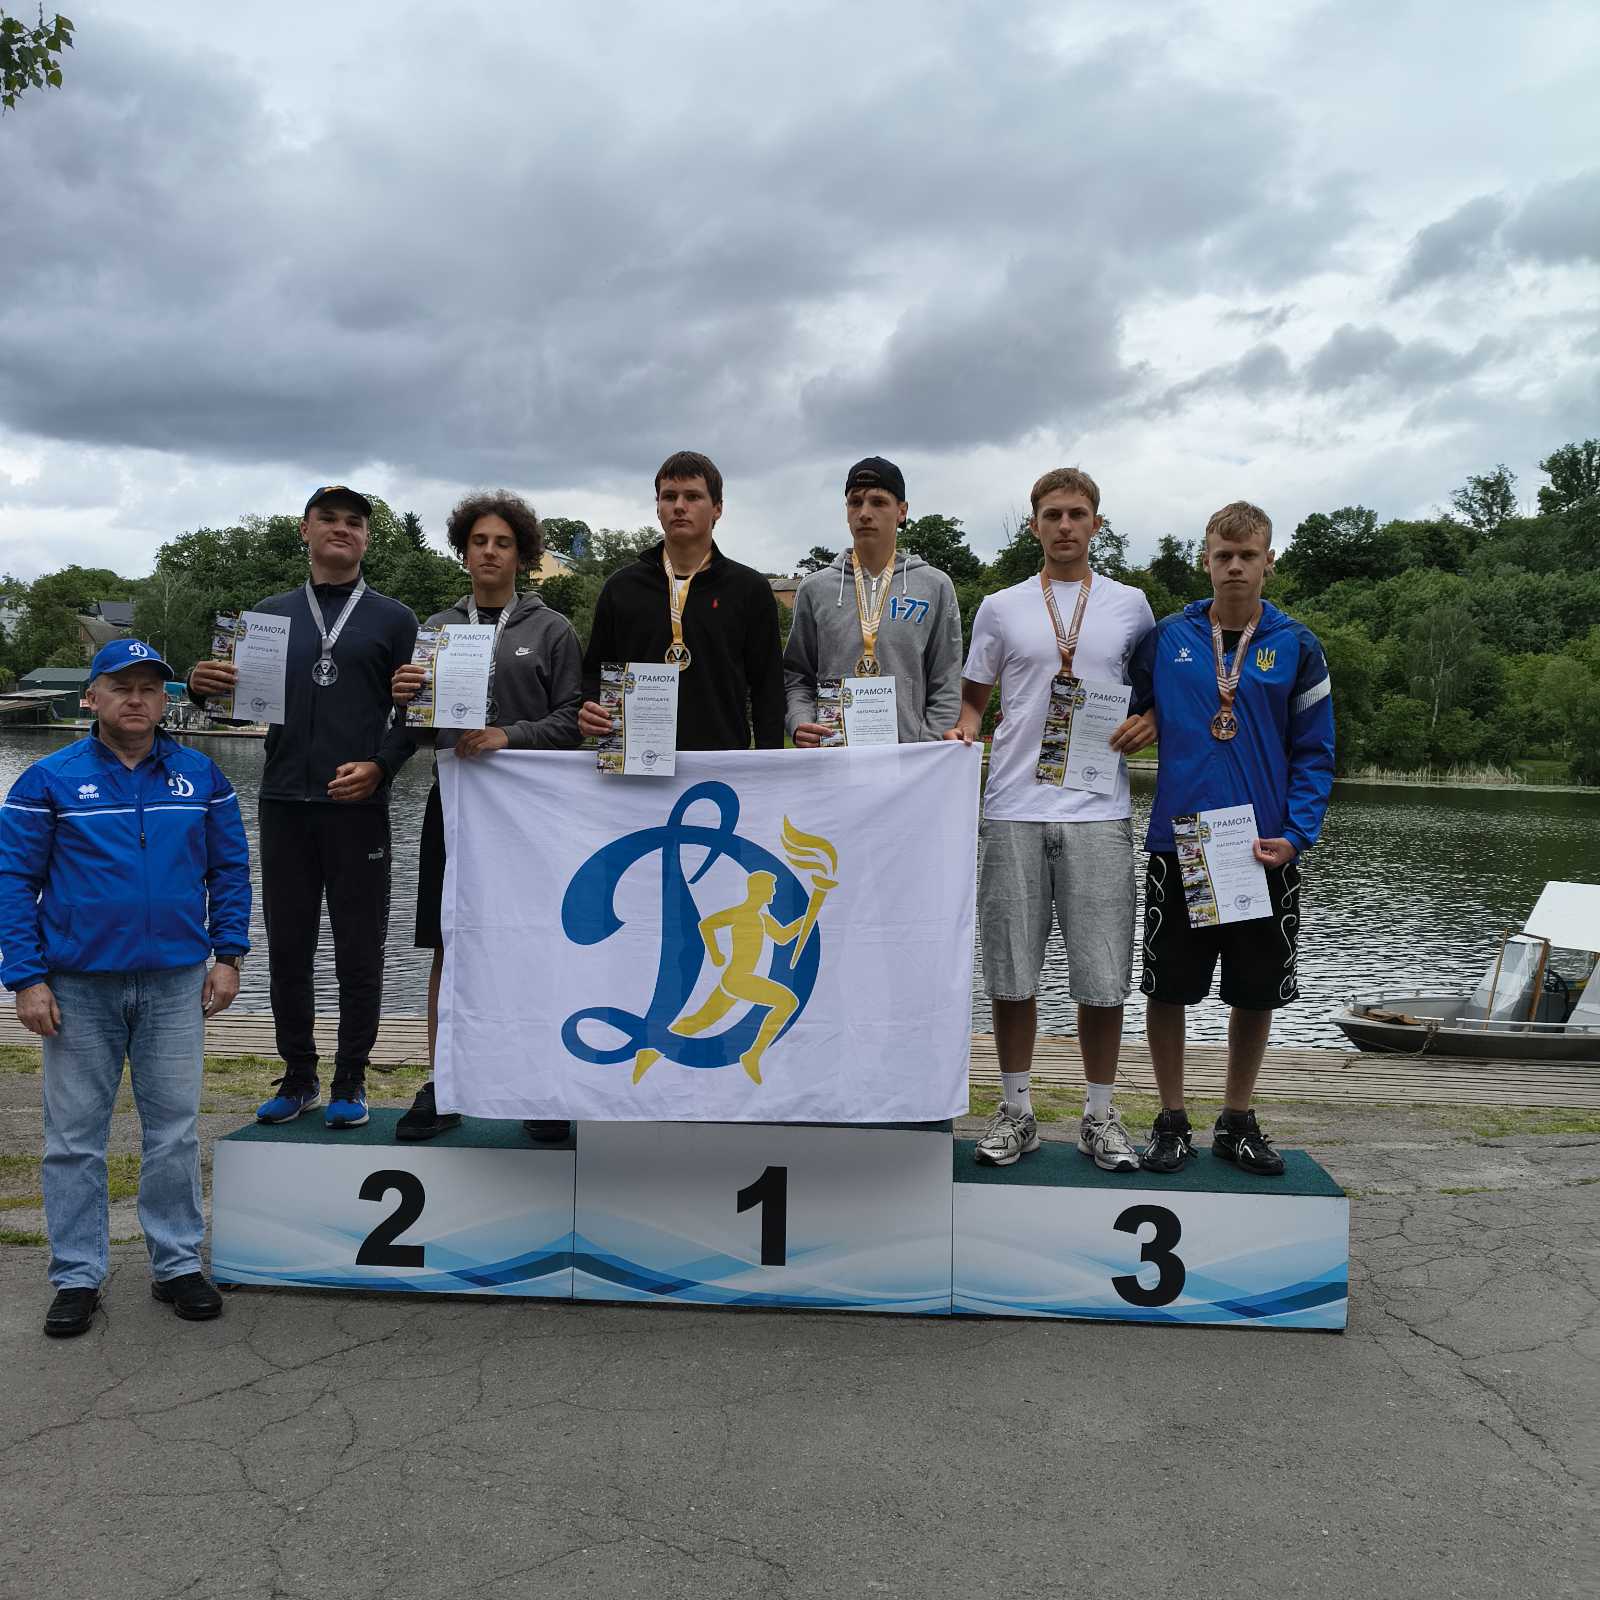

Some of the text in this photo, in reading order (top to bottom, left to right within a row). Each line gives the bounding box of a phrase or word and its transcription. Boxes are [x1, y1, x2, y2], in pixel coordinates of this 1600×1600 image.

[890, 596, 929, 624] 1-77
[249, 624, 286, 635] ГРАМОТА
[453, 633, 490, 641] ГРАМОТА
[638, 674, 676, 683] ГРАМОТА
[855, 687, 892, 696] ГРАМОТА
[1089, 692, 1127, 704] ГРАМОТА
[1212, 816, 1252, 828] ГРАМОТА
[355, 1169, 426, 1268] 2
[736, 1165, 788, 1267] 1
[1111, 1204, 1186, 1307] 3
